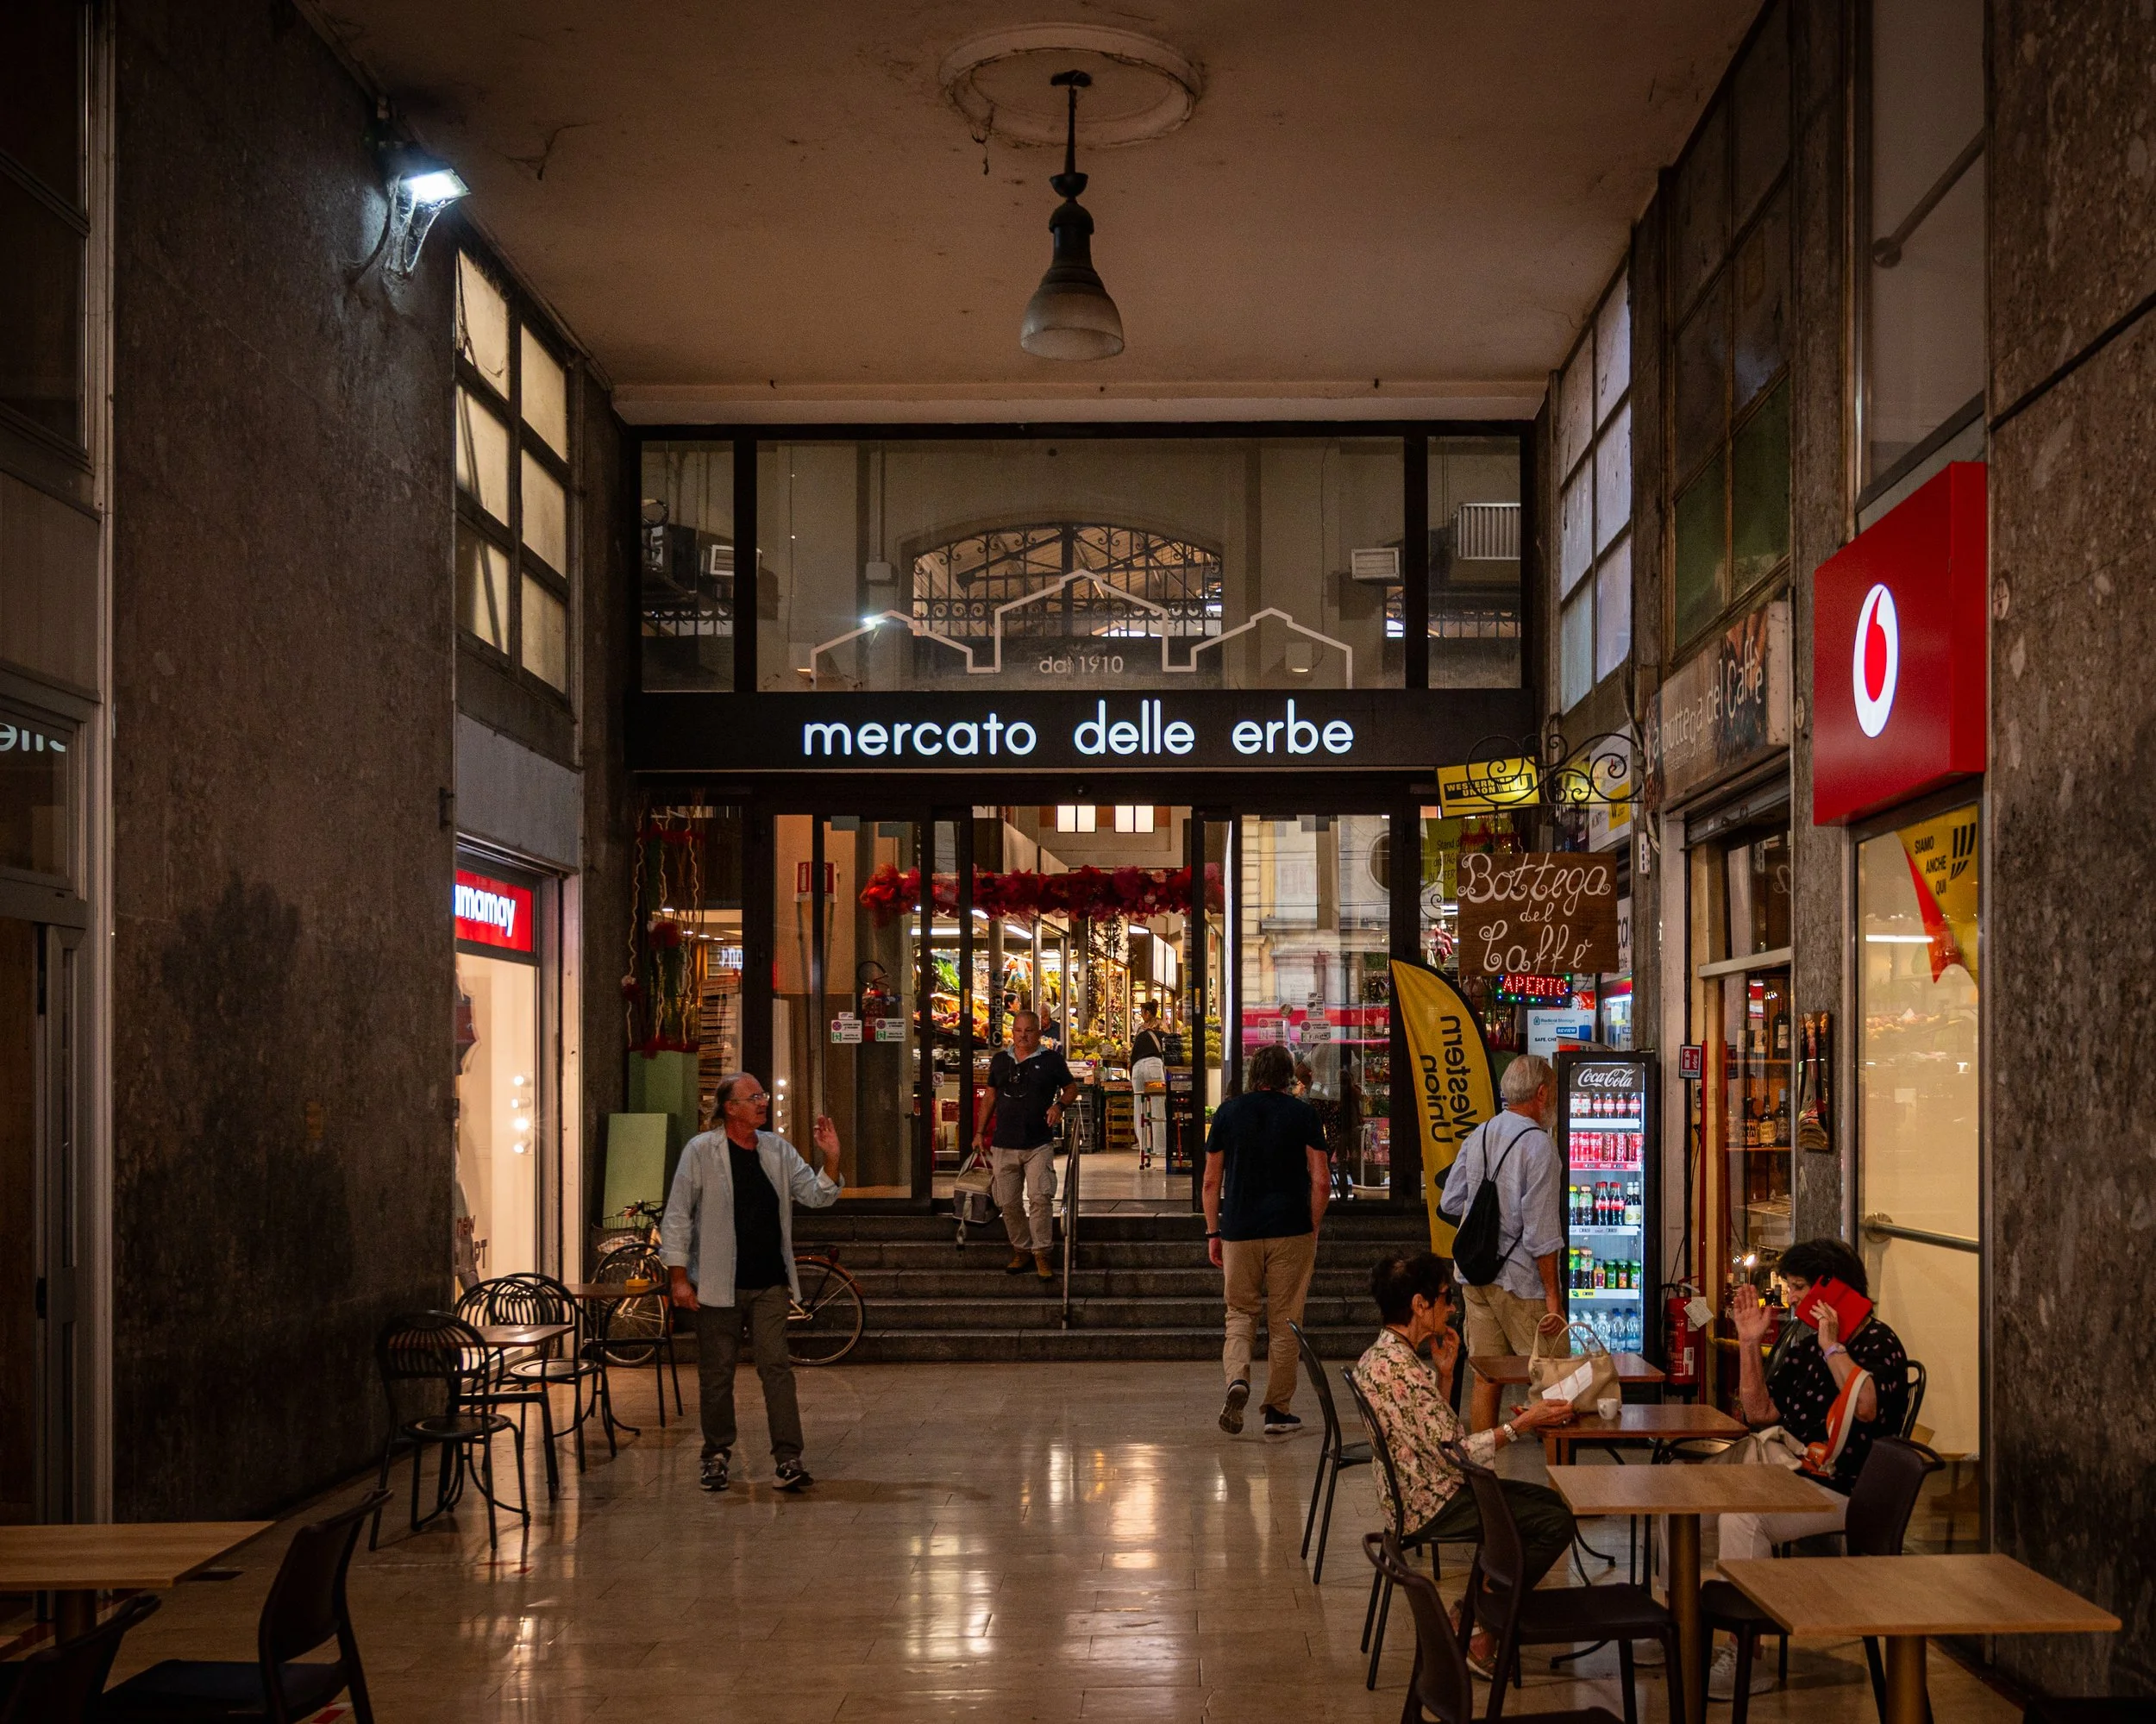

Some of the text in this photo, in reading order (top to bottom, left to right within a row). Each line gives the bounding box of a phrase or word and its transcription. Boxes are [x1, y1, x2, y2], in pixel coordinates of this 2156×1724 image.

[1039, 655, 1124, 674] dal 1910
[1707, 659, 1723, 725] del
[1727, 636, 1763, 719] Caffè
[805, 699, 1353, 755] mercato delle erbe
[1915, 836, 1934, 855] SIAMO
[1926, 855, 1946, 874] ANCHE
[1457, 852, 1612, 916] Bottega
[1935, 879, 1946, 896] QUI
[1520, 900, 1554, 923] del
[1478, 919, 1594, 974] Caffè
[1502, 975, 1567, 995] APERTO
[991, 998, 1002, 1046] Melinda
[1577, 1068, 1636, 1087] Coca-Cola
